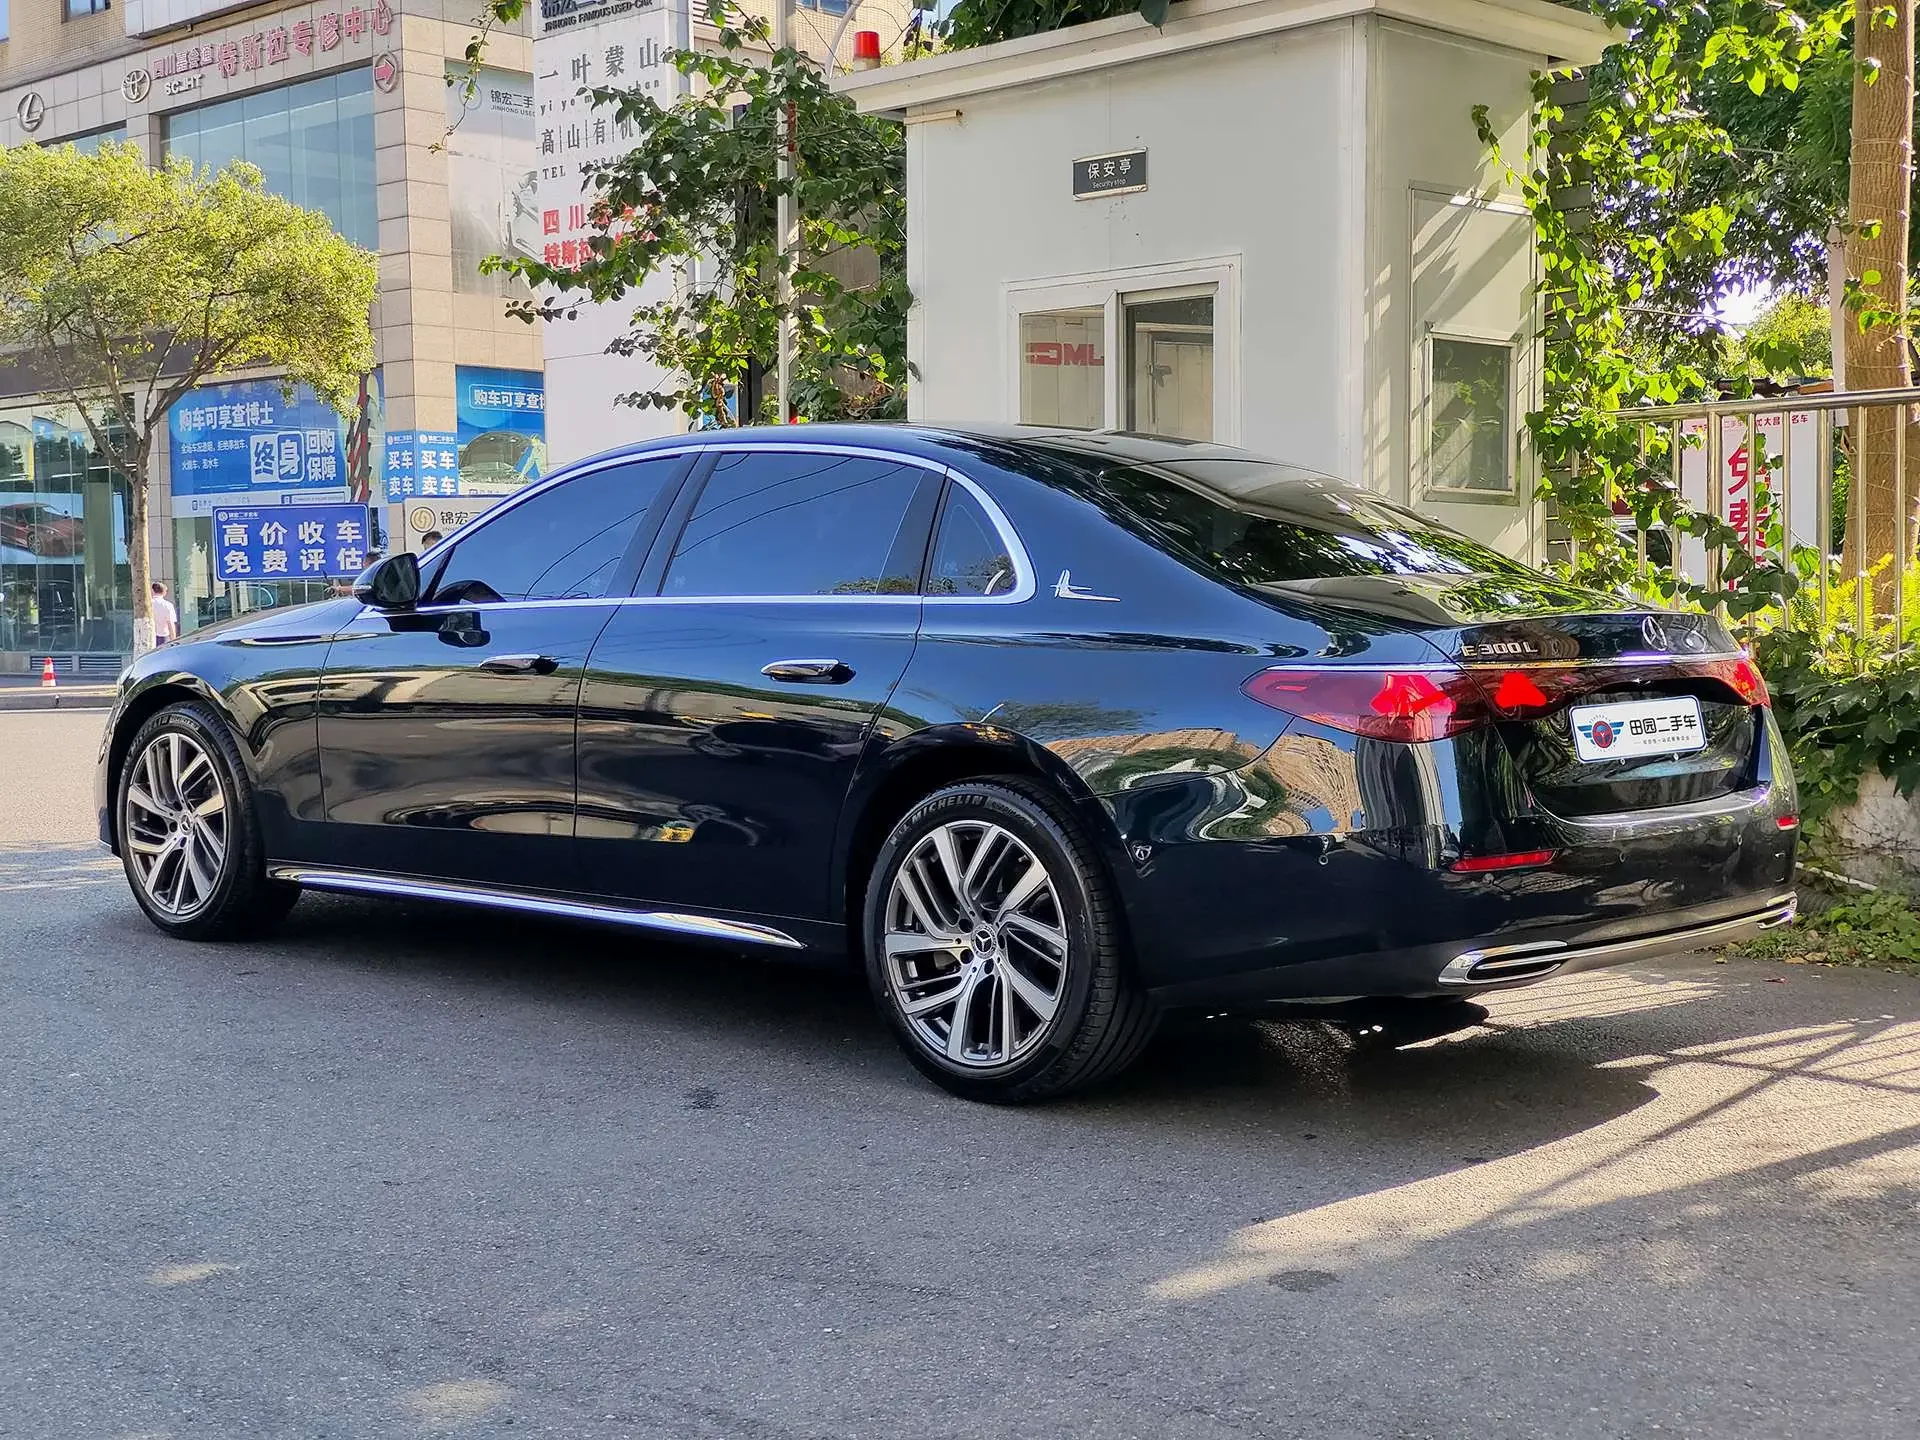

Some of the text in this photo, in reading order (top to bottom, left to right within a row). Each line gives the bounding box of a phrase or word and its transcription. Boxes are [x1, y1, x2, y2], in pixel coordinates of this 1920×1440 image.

[543, 15, 577, 32] JINHONG
[579, 7, 611, 23] FAMOUS
[217, 0, 393, 78] 特斯拉专修中心
[543, 165, 566, 180] TEL
[1088, 158, 1131, 179] 保安亭
[1092, 180, 1113, 189] Security
[179, 401, 274, 432] 购车可享查博士
[255, 440, 300, 475] 终身
[306, 430, 335, 455] 回购
[388, 450, 413, 470] 买车
[421, 450, 456, 470] 买车
[307, 456, 337, 481] 保障
[389, 476, 414, 496] 卖车
[422, 476, 457, 495] 卖车
[222, 519, 363, 547] 高价收车
[224, 547, 363, 574] 免费评估
[1462, 641, 1539, 657] E 300 L
[1629, 714, 1697, 736] 田园二手车
[911, 795, 984, 824] MICHELIN
